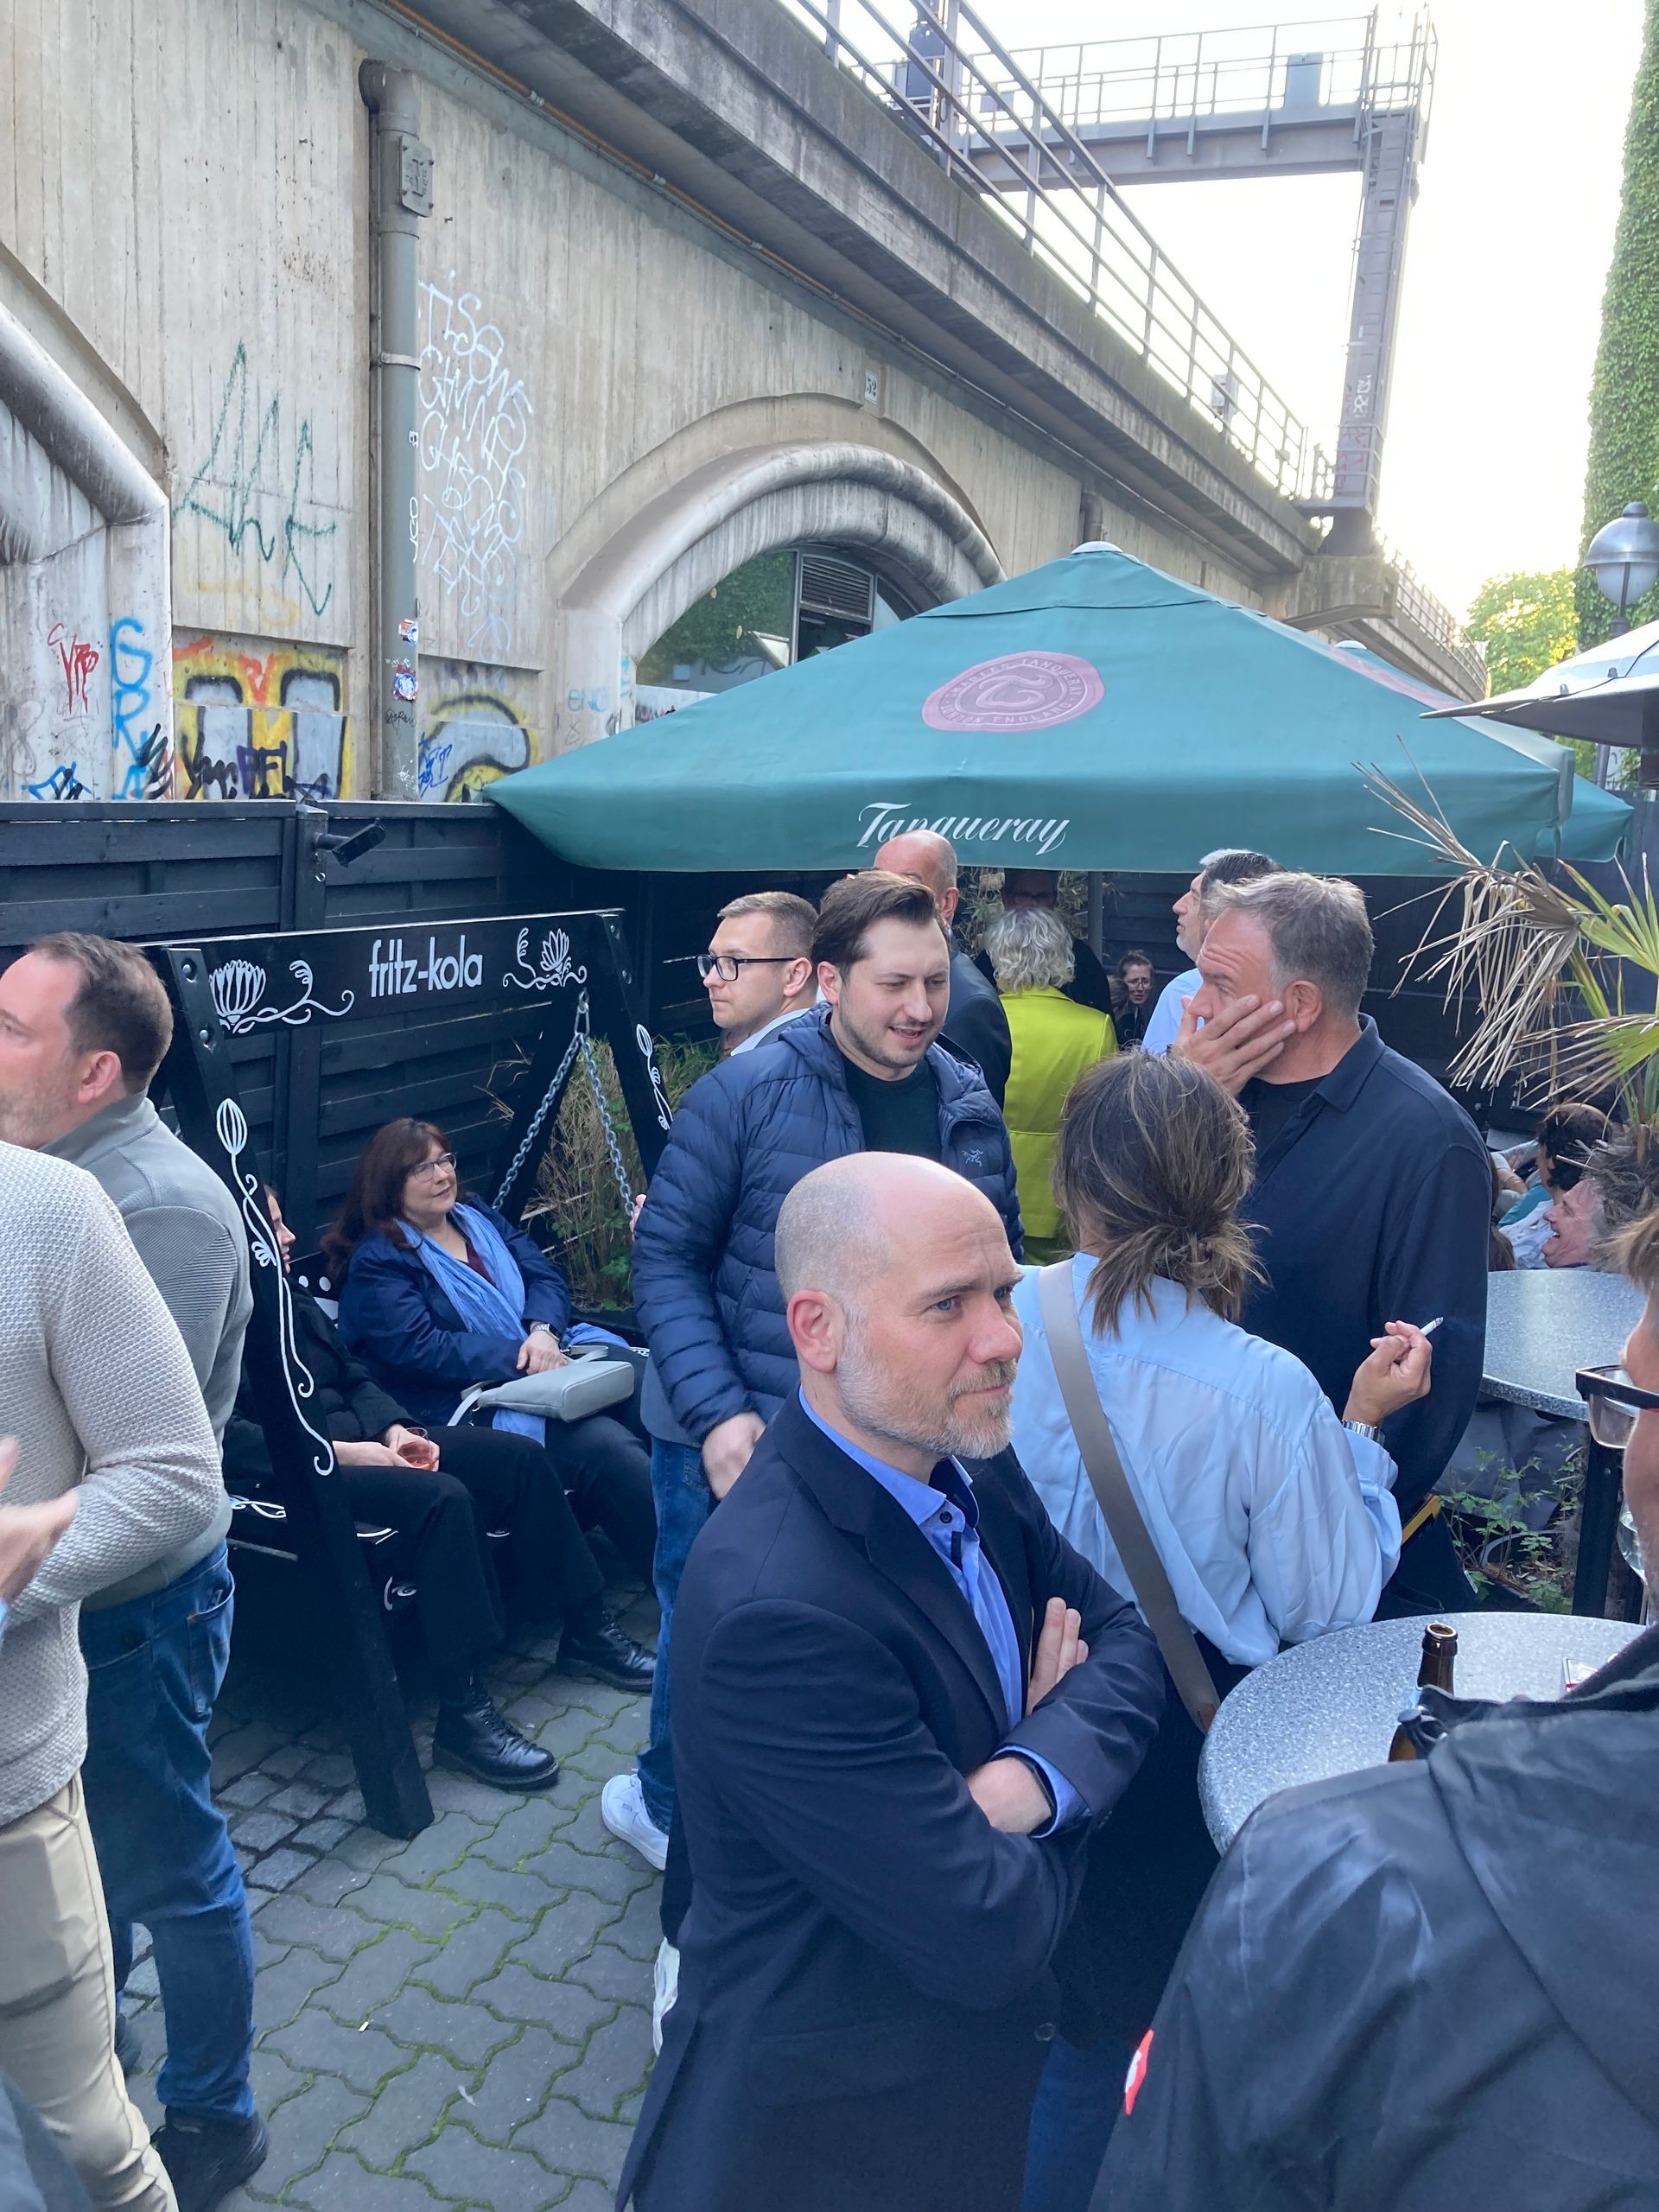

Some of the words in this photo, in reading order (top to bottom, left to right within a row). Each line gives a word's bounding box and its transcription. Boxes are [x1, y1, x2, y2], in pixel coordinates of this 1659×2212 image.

[1021, 658, 1083, 696] TANQUERAY
[992, 702, 1072, 724] ENGLAND
[856, 802, 1071, 855] Tanqueray
[368, 934, 483, 998] fritz-kola
